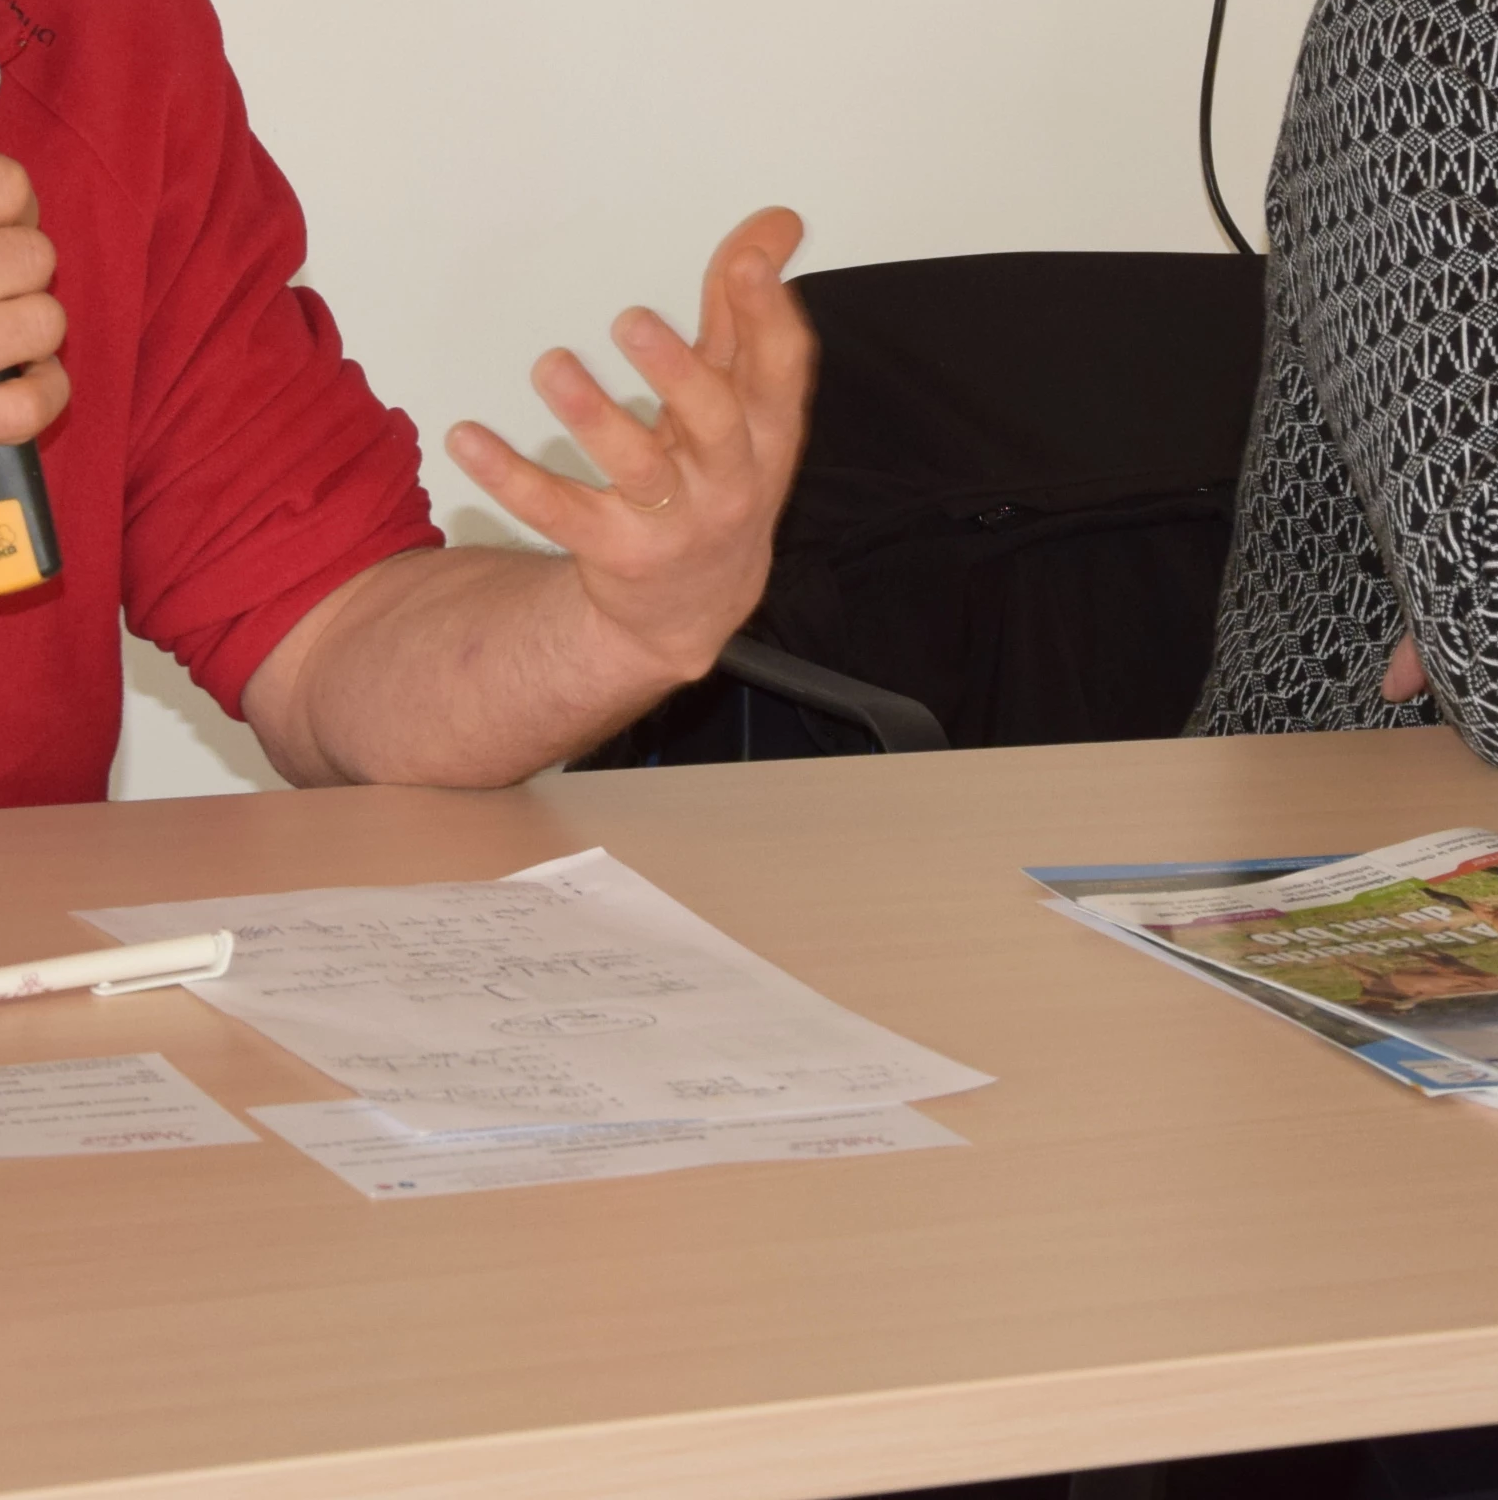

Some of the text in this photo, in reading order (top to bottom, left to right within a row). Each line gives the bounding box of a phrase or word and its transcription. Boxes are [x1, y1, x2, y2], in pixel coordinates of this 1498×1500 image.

[1250, 905, 1452, 946] du lait bio
